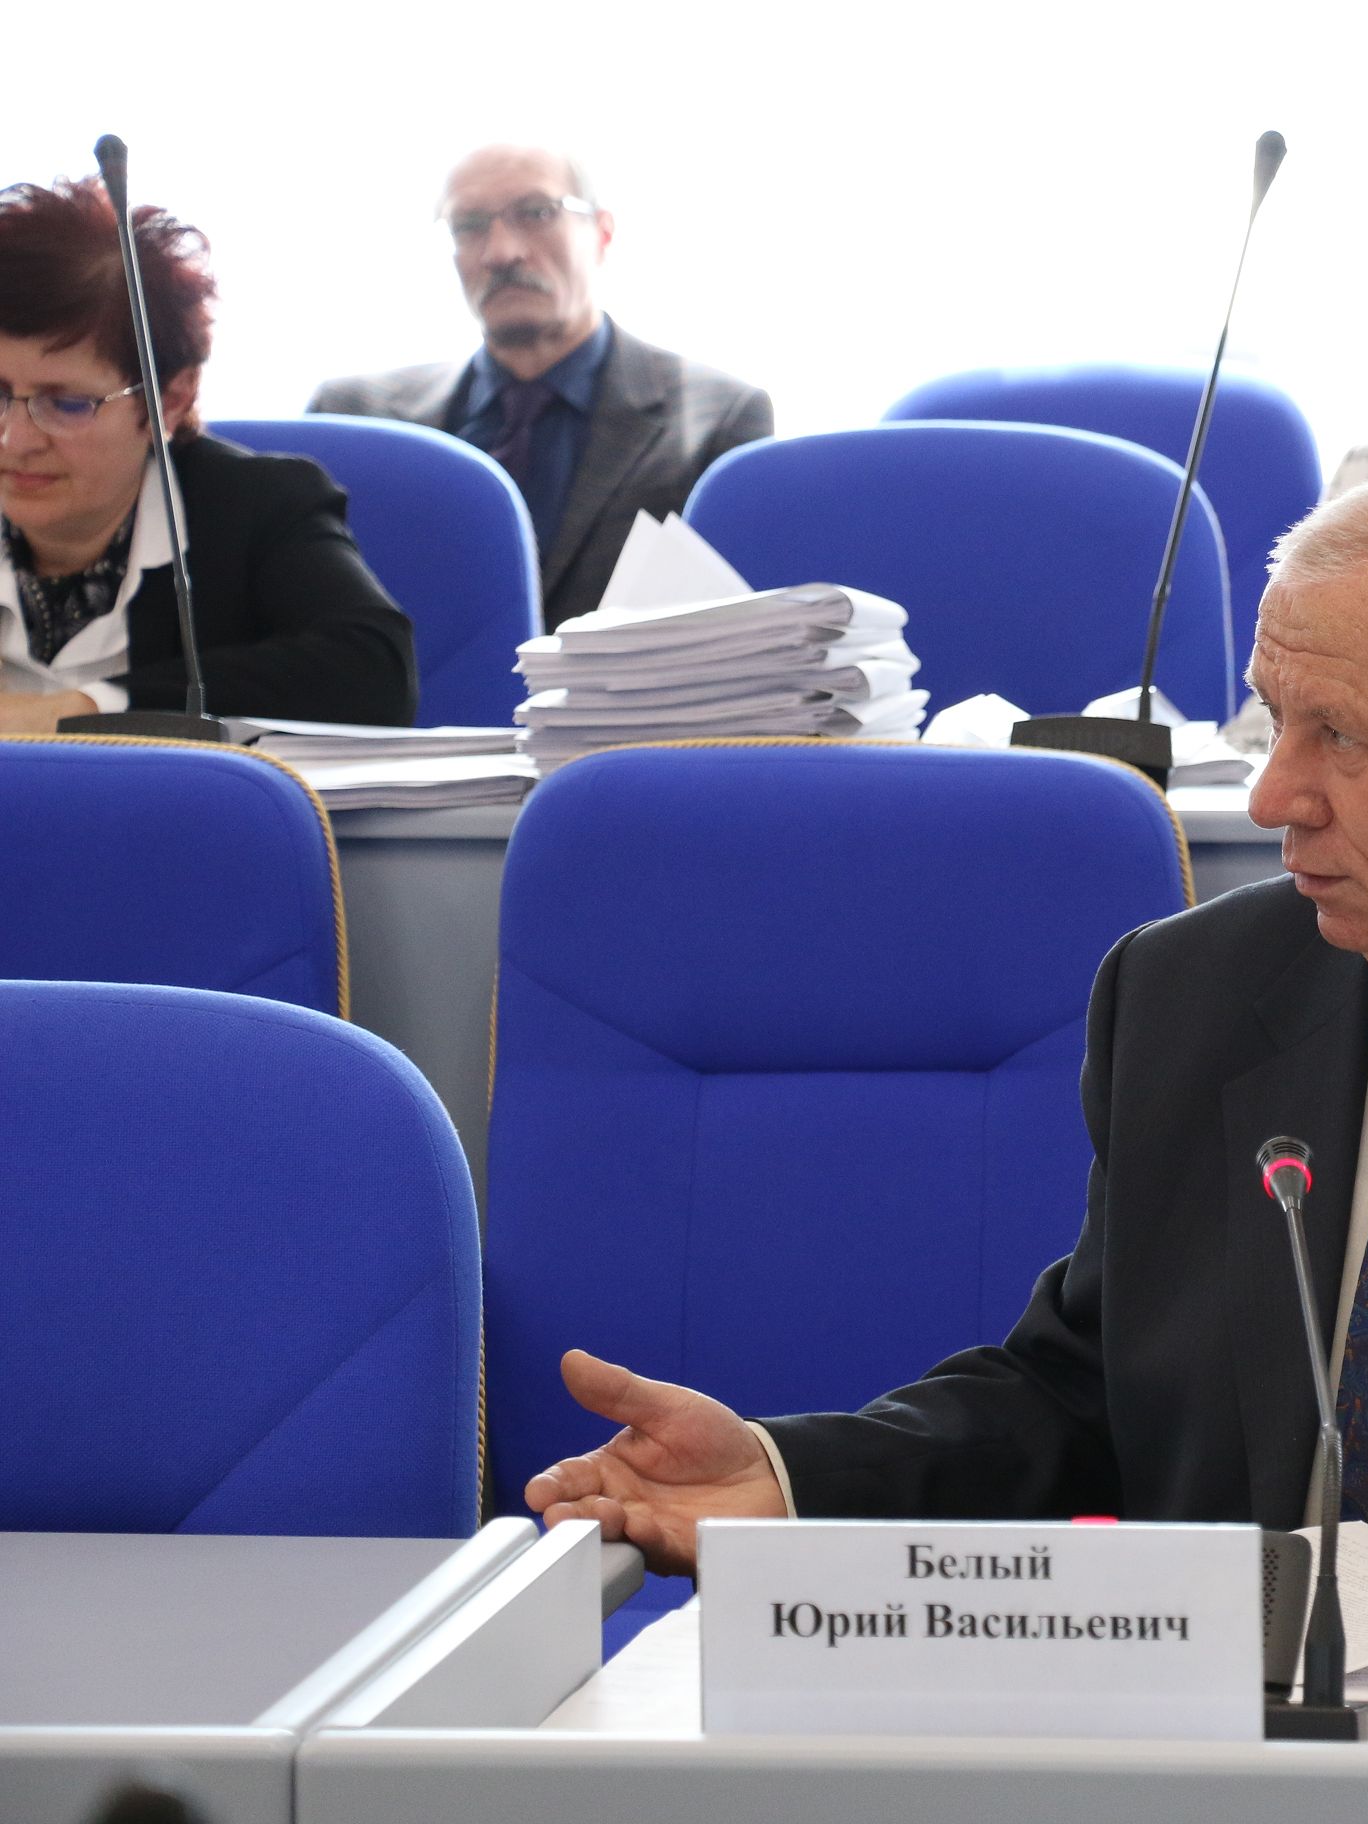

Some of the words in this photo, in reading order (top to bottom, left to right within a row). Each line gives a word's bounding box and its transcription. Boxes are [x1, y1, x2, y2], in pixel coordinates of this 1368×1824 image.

[905, 1543, 1053, 1580] Белый
[771, 1601, 909, 1647] Юрий
[923, 1603, 1190, 1641] Васильевич
